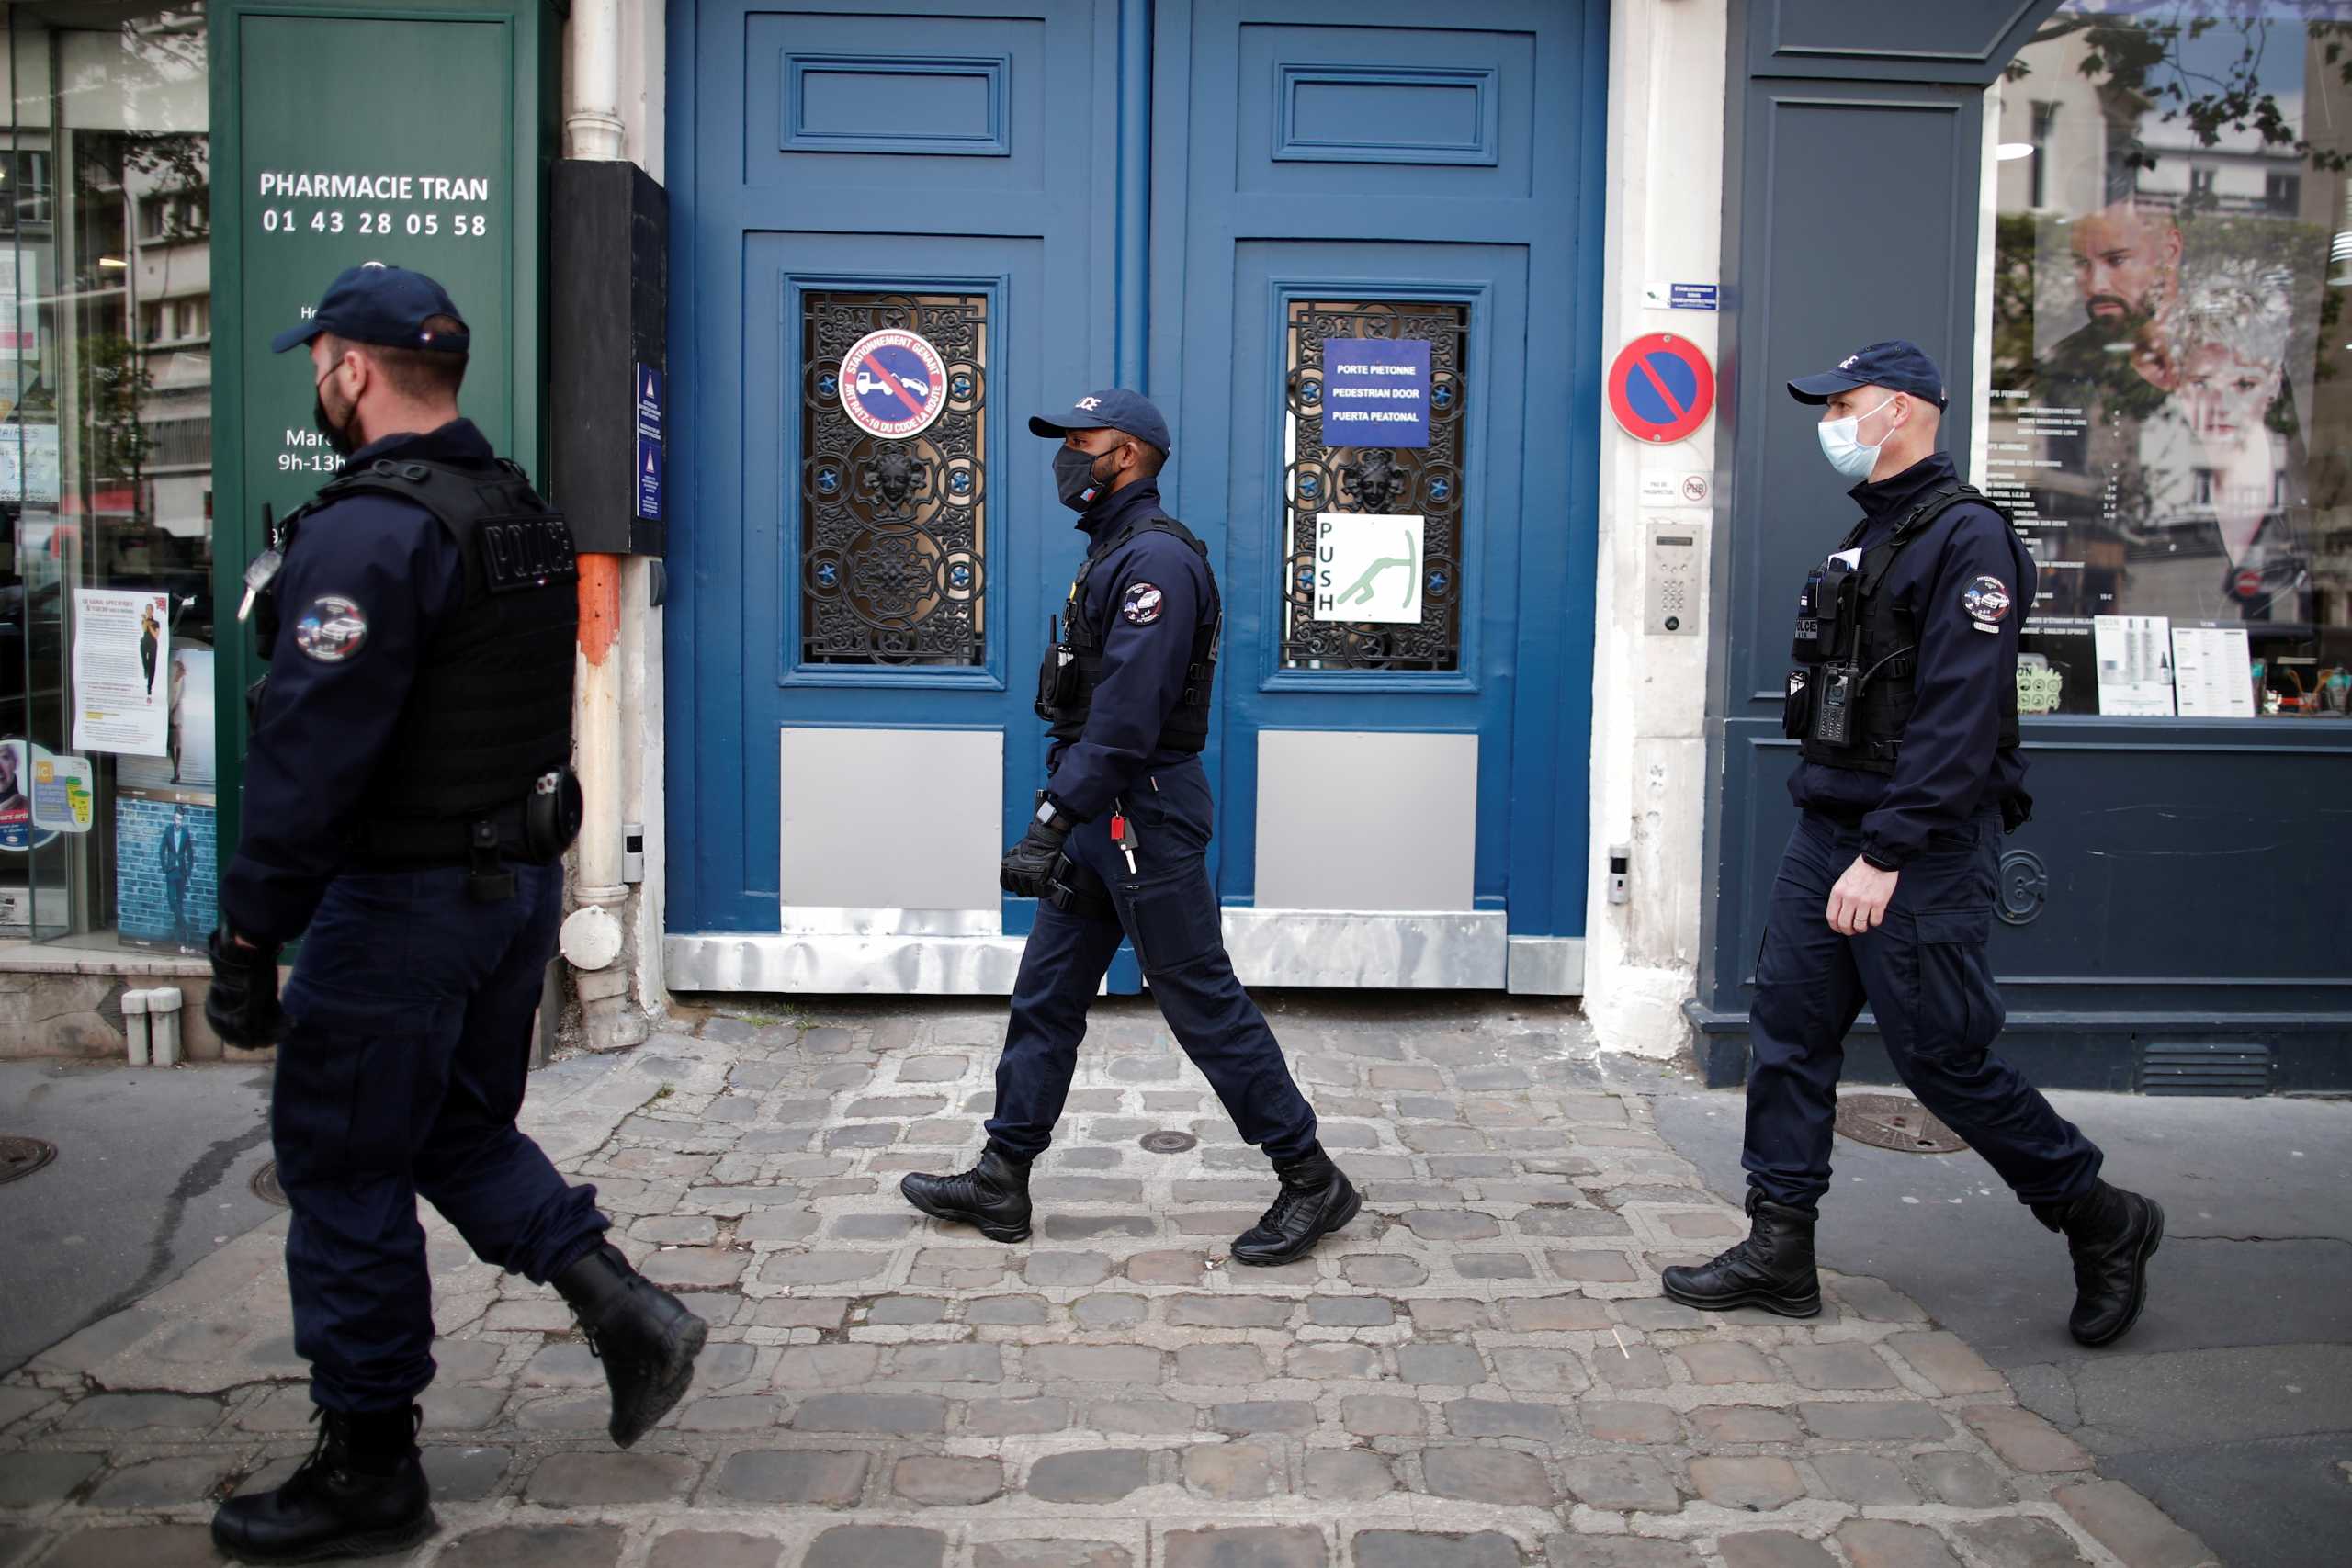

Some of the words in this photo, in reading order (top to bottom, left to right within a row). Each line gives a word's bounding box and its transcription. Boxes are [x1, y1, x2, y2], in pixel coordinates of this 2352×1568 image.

[260, 173, 413, 199] PHARMACIE
[419, 177, 489, 201] TRAN
[263, 209, 296, 232] 01
[311, 211, 344, 233] 43
[359, 212, 391, 234] 28
[406, 213, 438, 235] 05
[454, 214, 487, 236] 58
[846, 335, 913, 375] STATIONNEMENT
[1337, 365, 1369, 375] PORTE
[1370, 366, 1416, 376] PIETONNE
[1332, 388, 1391, 398] PEDESTRIAN
[1392, 389, 1419, 399] DOOR
[880, 423, 894, 433] DU
[894, 418, 918, 433] CODE
[1332, 411, 1369, 421] PUERTA
[1370, 412, 1419, 423] PEATONAL
[484, 521, 574, 581] POLICE
[1319, 522, 1334, 612] PUSH
